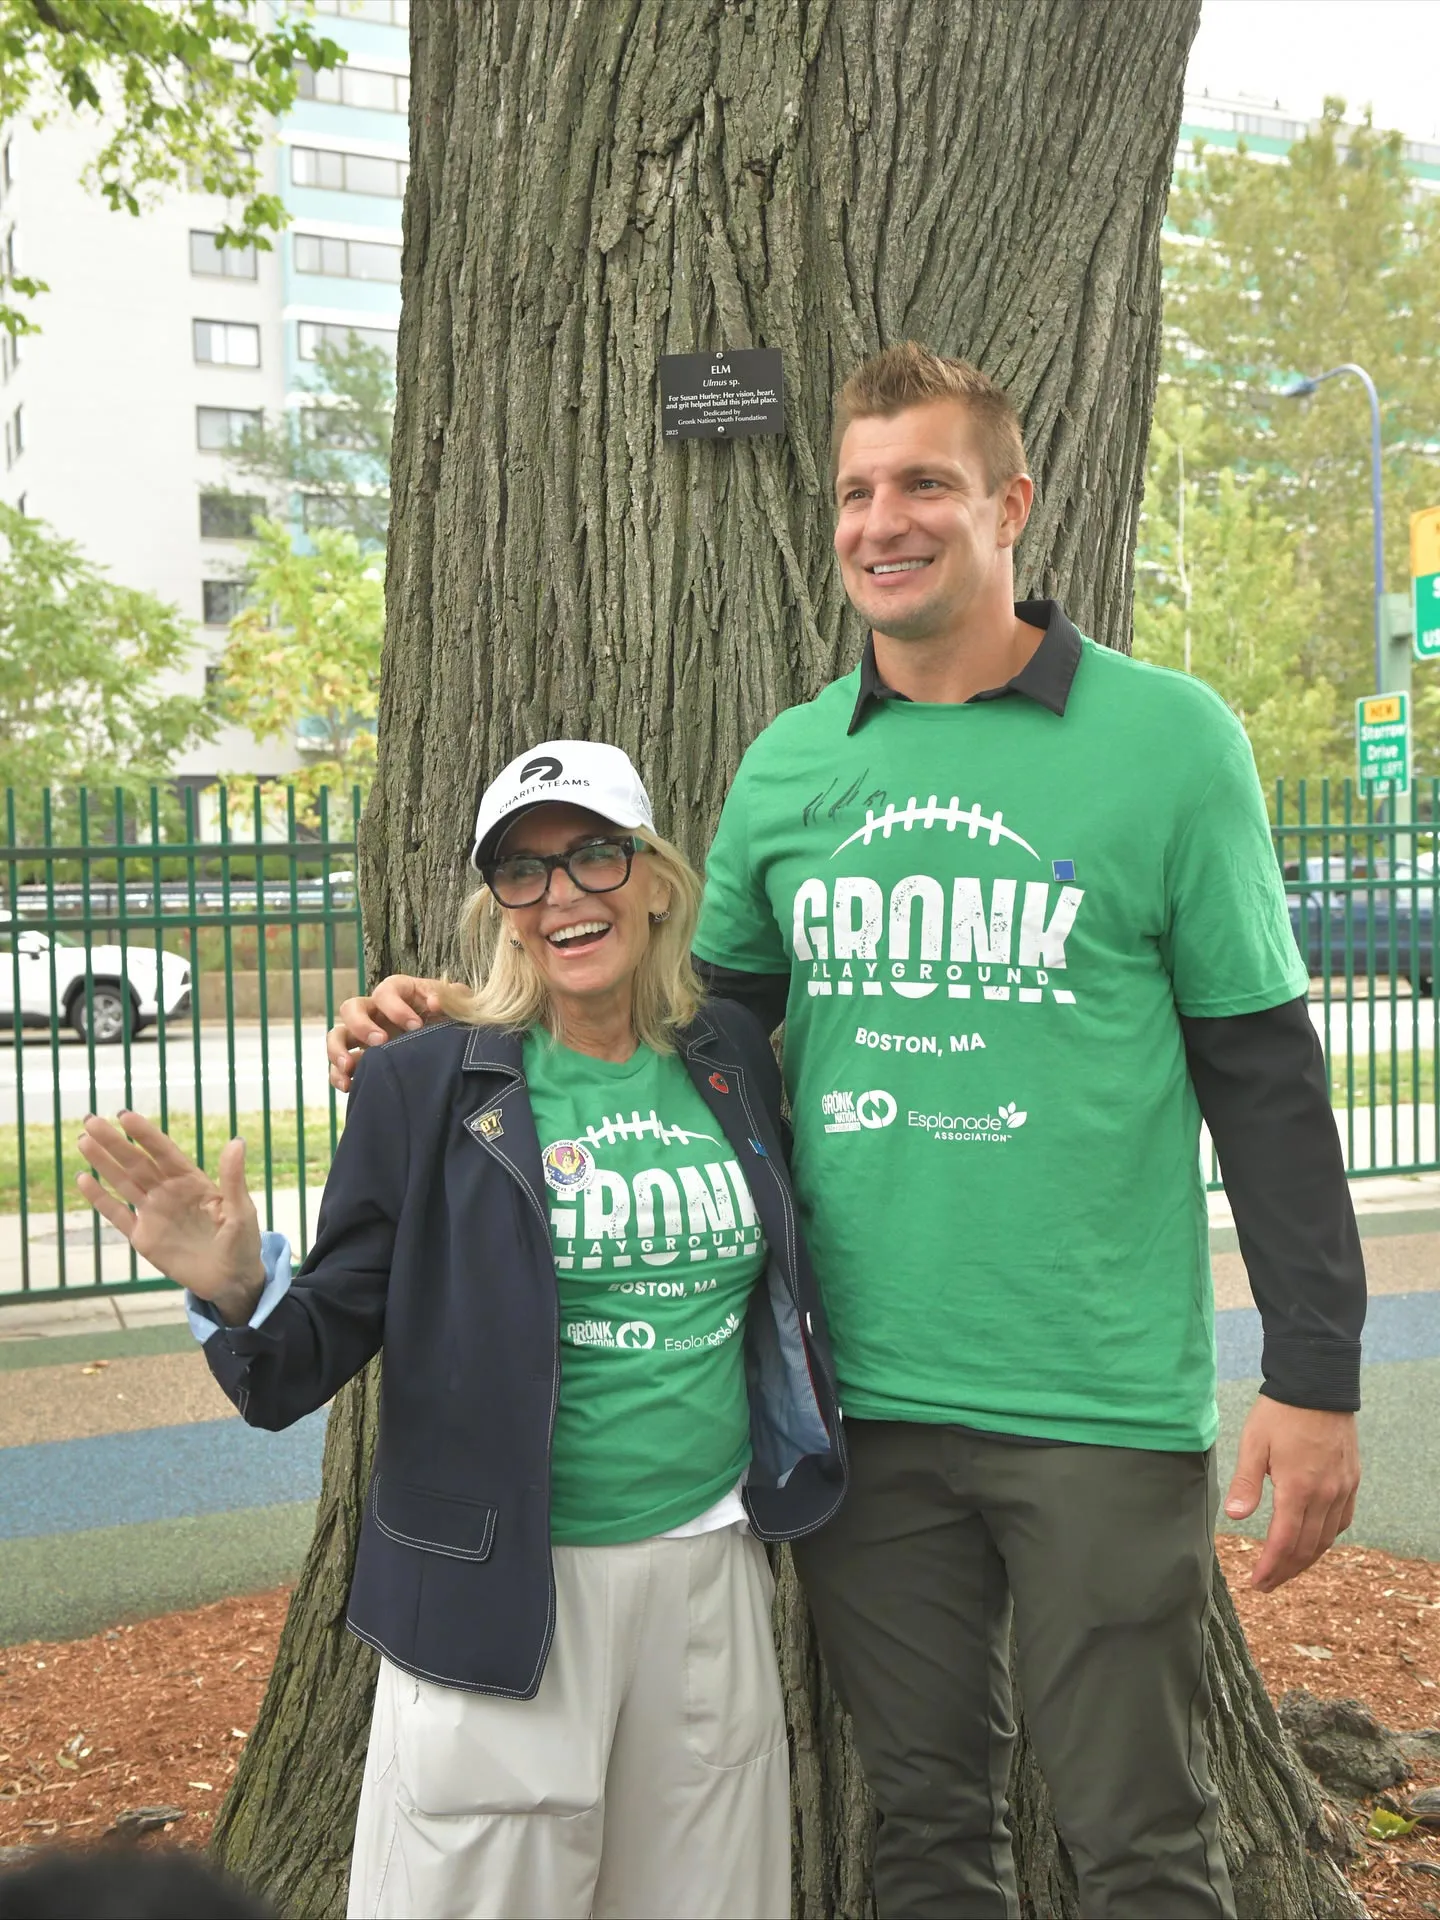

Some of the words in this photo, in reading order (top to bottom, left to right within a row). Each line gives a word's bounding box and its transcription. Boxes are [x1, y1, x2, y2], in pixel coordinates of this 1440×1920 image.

[711, 364, 731, 375] ELM
[702, 379, 727, 388] Ulmus
[665, 402, 678, 410] and
[678, 401, 690, 410] grit
[690, 400, 711, 409] helped
[712, 399, 728, 407] build
[729, 398, 741, 406] this
[741, 397, 759, 406] joyful
[760, 396, 779, 405] place.
[699, 392, 722, 401] Hurley:
[722, 391, 735, 399] Her
[735, 390, 756, 398] vision,
[756, 388, 775, 397] heart,
[677, 418, 696, 426] Gronk
[697, 416, 717, 425] Nation
[717, 415, 734, 423] Youth
[735, 414, 768, 422] Foundation
[703, 408, 733, 417] Dedicated
[733, 408, 741, 416] by
[1422, 629, 1440, 648] US
[1370, 703, 1393, 717] NEW
[1366, 744, 1398, 761] Drive
[499, 779, 590, 814] CHARITYTEAMS
[793, 874, 1085, 1004] GRONK
[812, 962, 1049, 986] PLAYGROUND
[855, 1027, 943, 1057] BOSTON,
[950, 1033, 986, 1052] MA
[821, 1090, 855, 1115] GRÖNK
[481, 1115, 497, 1133] 87
[908, 1110, 1002, 1132] Esplanade
[934, 1131, 1007, 1143] ASSOCIATION
[567, 1228, 762, 1256] LAYGROUND
[608, 1281, 687, 1298] BOSTON,
[694, 1278, 717, 1294] MA
[567, 1320, 613, 1341] GRÖNK
[665, 1326, 732, 1352] Esplanade
